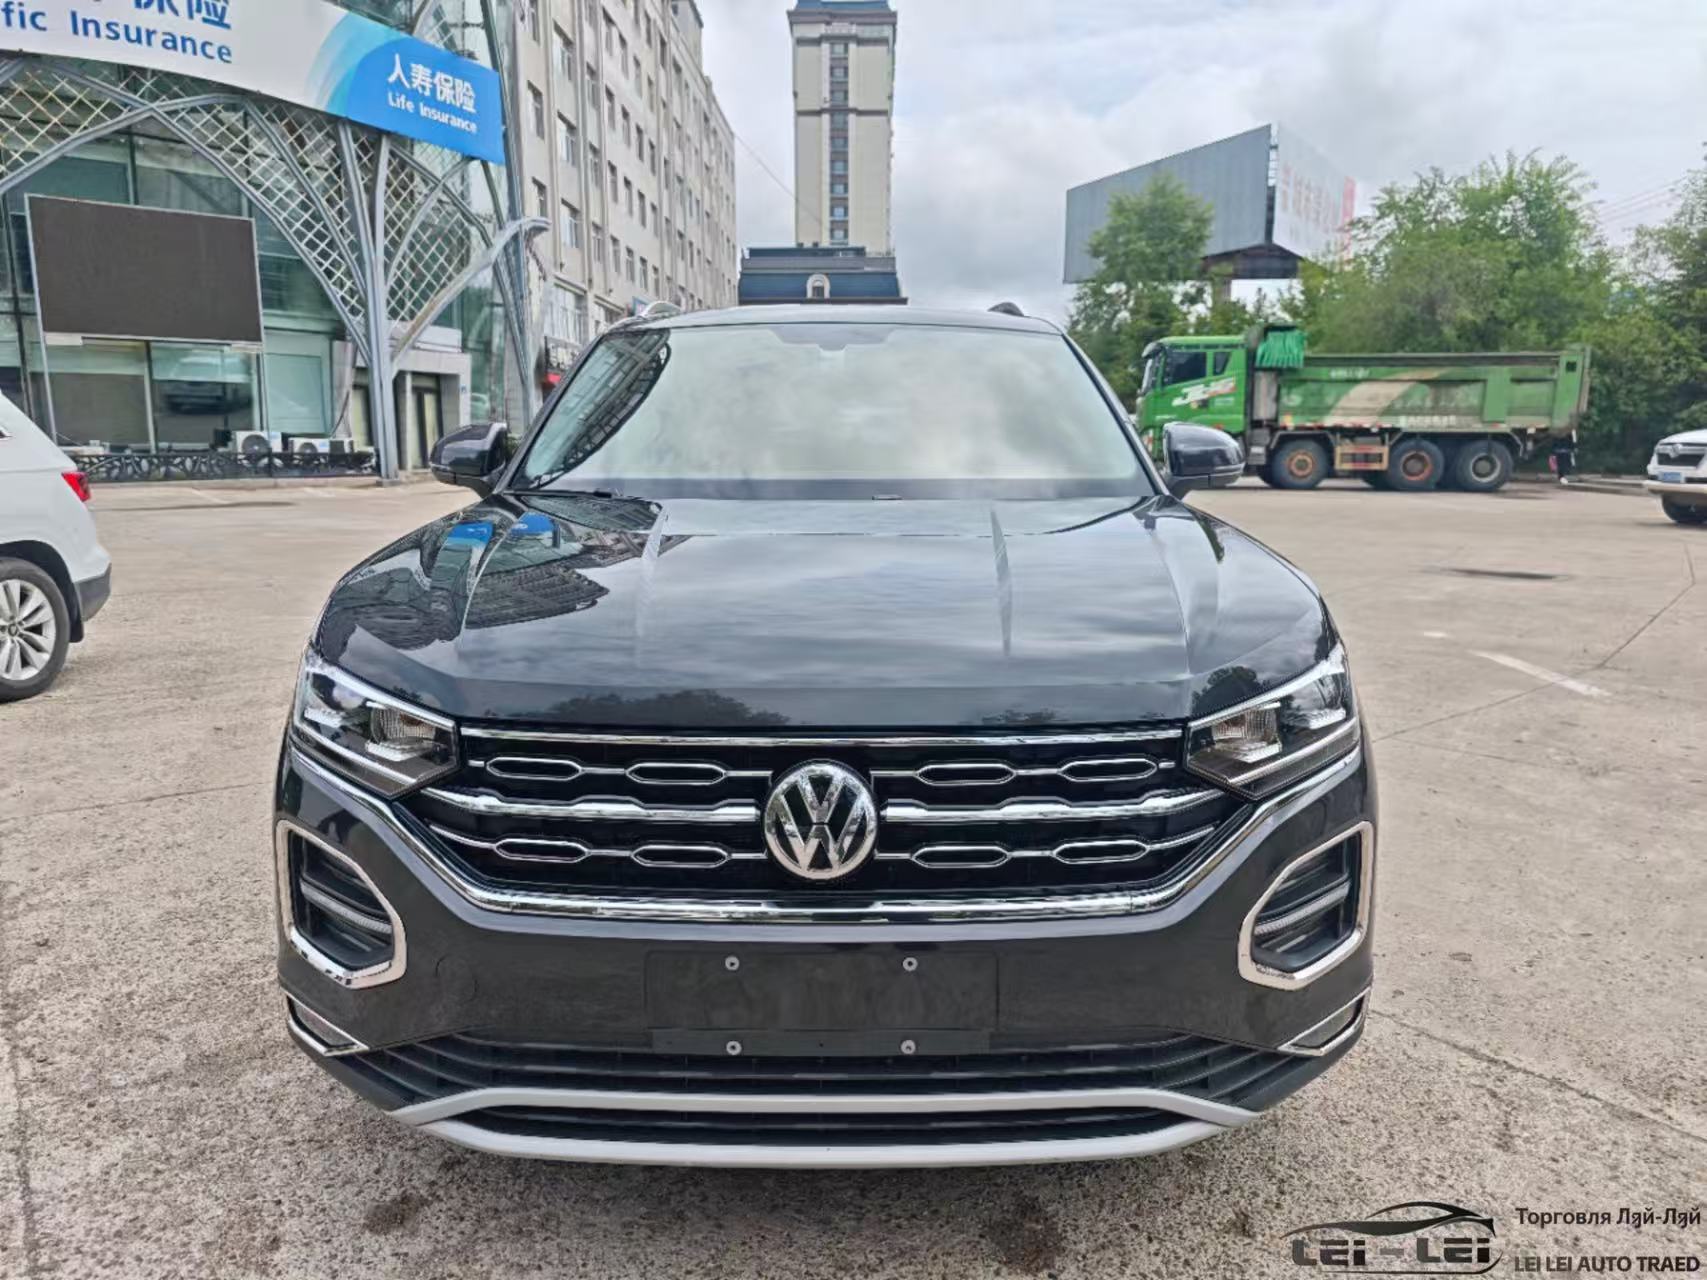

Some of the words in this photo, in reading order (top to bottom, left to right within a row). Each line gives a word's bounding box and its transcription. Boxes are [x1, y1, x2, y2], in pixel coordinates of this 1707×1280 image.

[1, 1, 47, 31] fic
[70, 10, 232, 64] Insurance
[388, 53, 477, 114] 人寿保险
[388, 91, 415, 113] Life
[420, 102, 477, 134] Insurance
